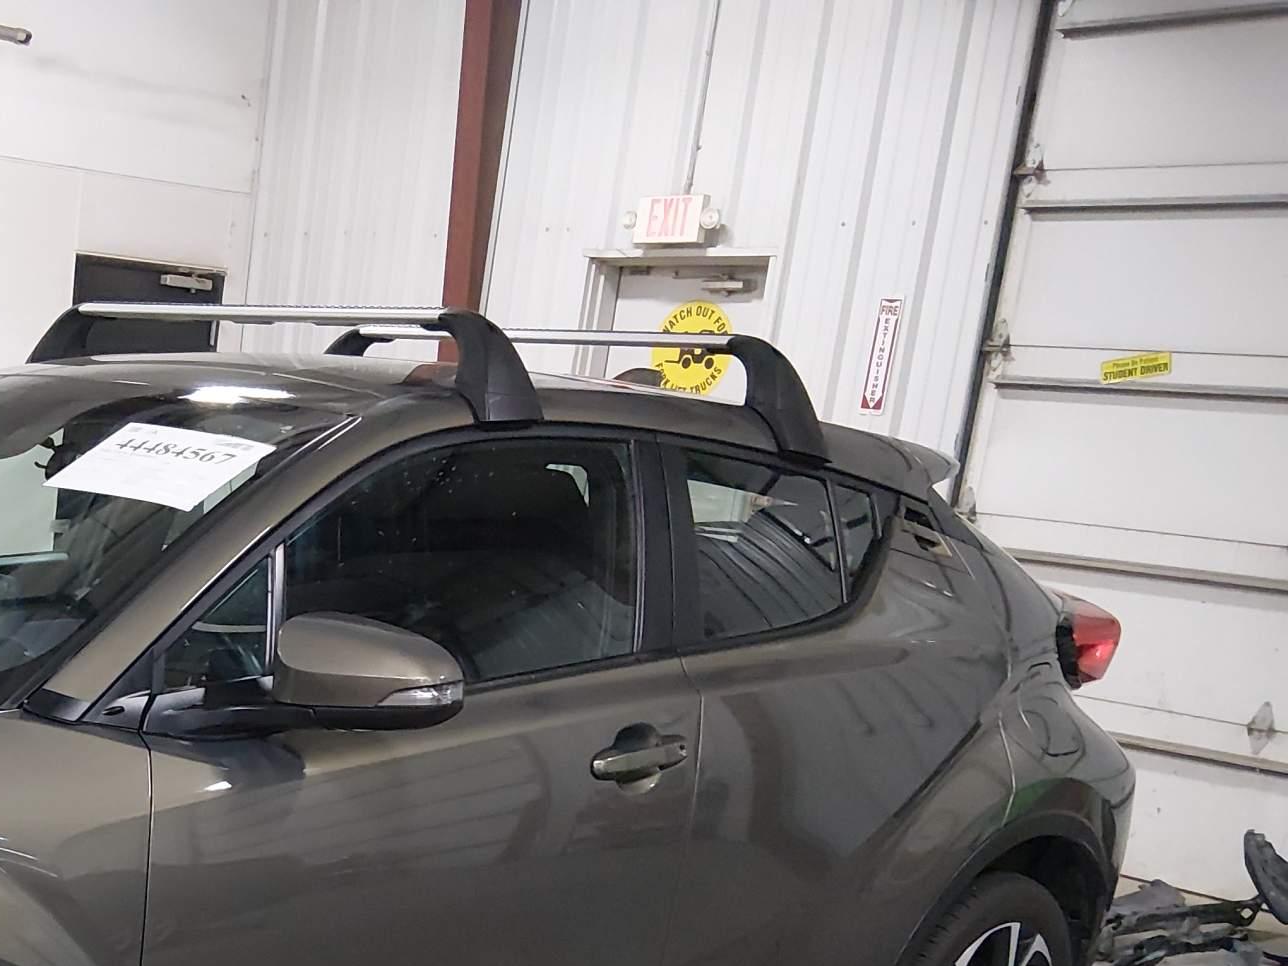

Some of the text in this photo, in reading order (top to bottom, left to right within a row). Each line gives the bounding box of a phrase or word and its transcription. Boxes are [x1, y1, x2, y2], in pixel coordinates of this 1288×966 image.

[646, 197, 693, 237] EXIT
[696, 305, 715, 320] OUT
[880, 305, 899, 316] FIRE
[690, 366, 722, 394] TRUCKS
[1103, 363, 1169, 381] STUDENT DRIVER
[116, 438, 237, 465] 44484567
